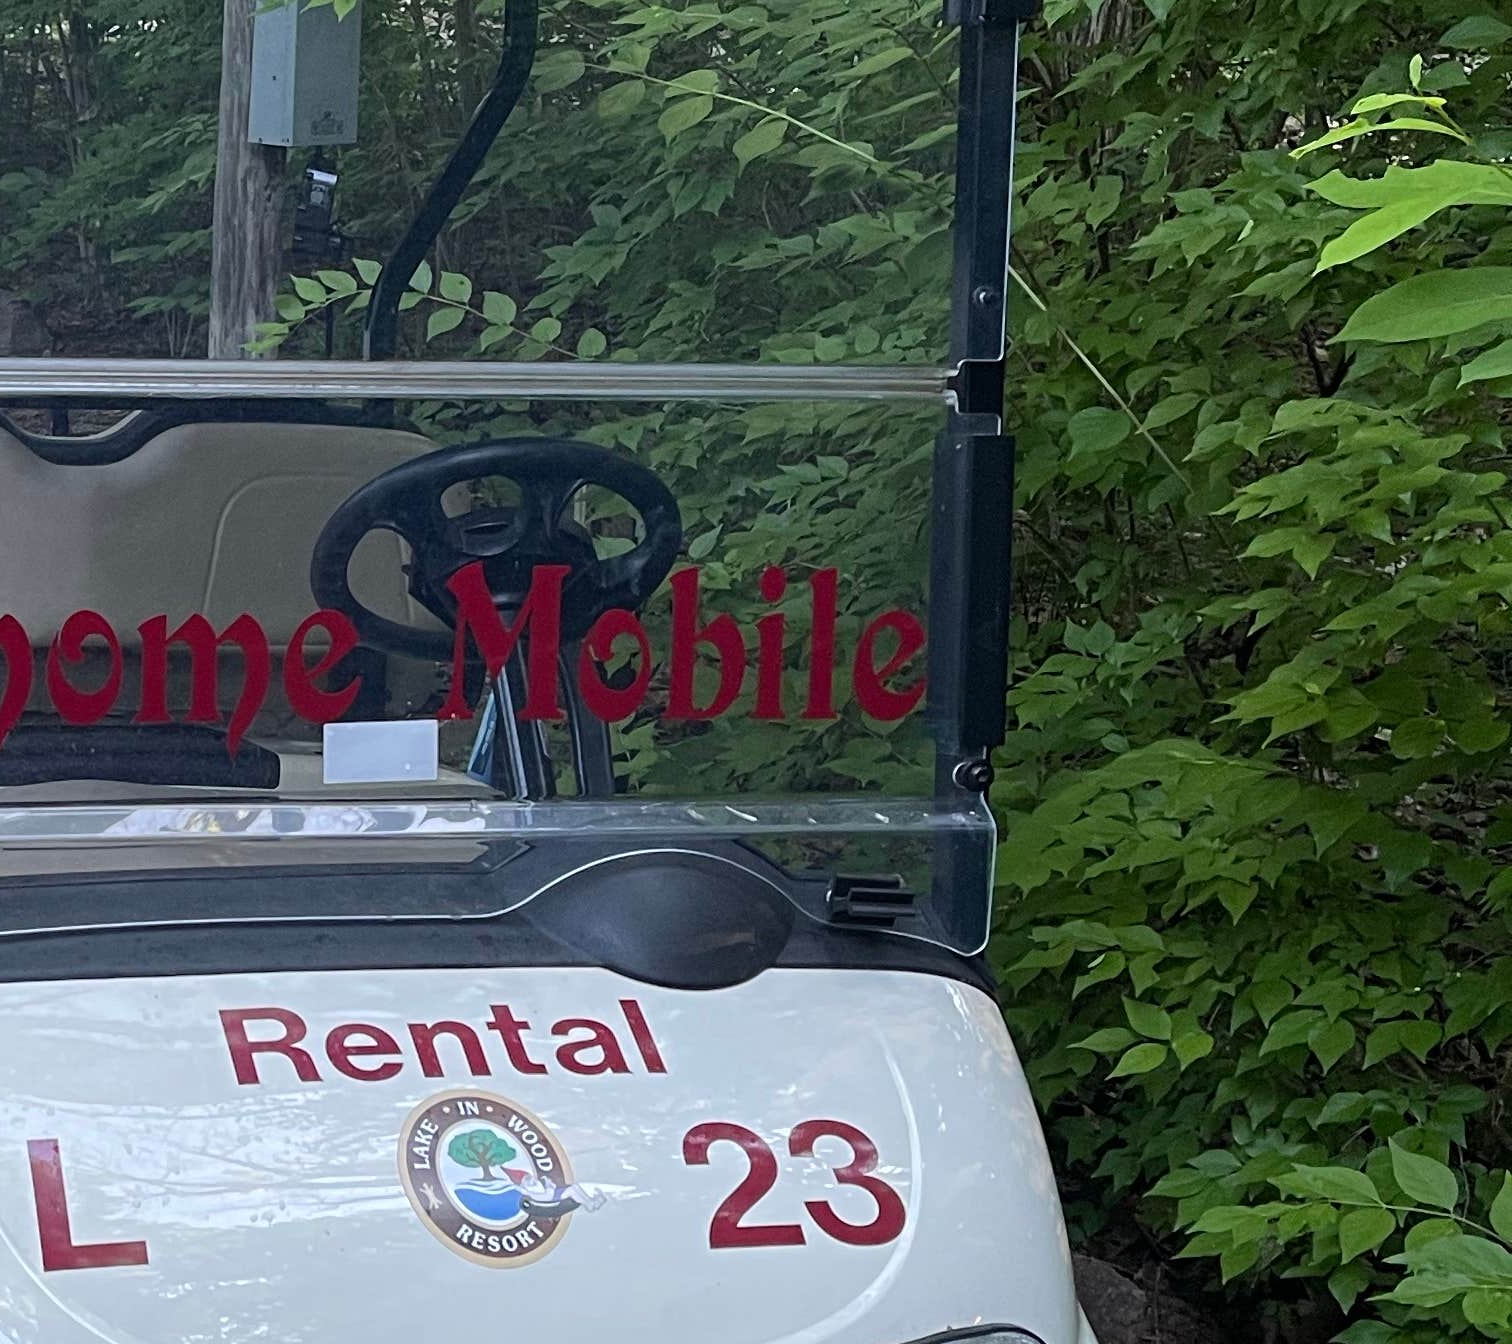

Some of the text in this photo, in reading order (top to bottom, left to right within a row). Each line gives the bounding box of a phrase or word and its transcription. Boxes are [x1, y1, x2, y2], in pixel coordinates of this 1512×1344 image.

[438, 561, 928, 723] Mobile
[219, 999, 667, 1085] Rental
[413, 1101, 553, 1171] LAKE IN WOOD
[683, 1119, 907, 1250] 23
[27, 1139, 149, 1272] L
[456, 1221, 544, 1252] RESORT
